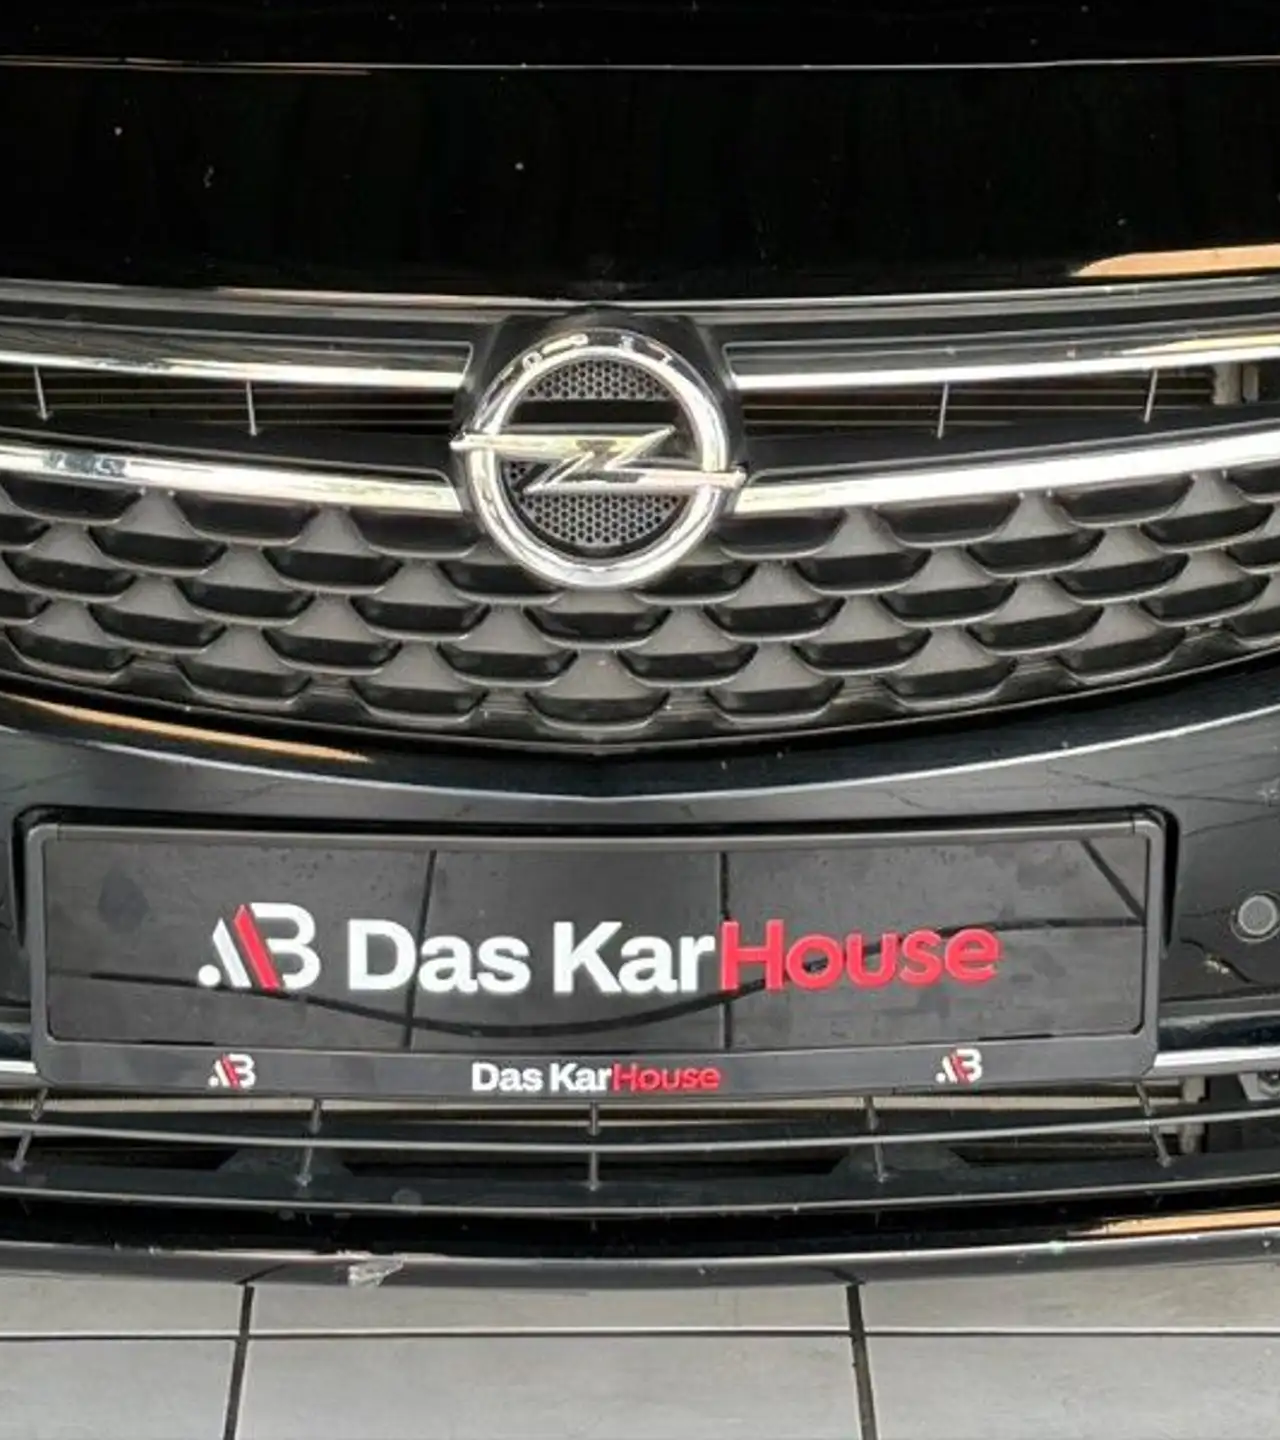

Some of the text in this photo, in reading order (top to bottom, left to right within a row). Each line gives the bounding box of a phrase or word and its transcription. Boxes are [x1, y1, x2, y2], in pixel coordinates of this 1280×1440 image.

[346, 918, 531, 994] Das
[552, 918, 1002, 994] KarHouse
[471, 1061, 721, 1093] Das KarHouse
